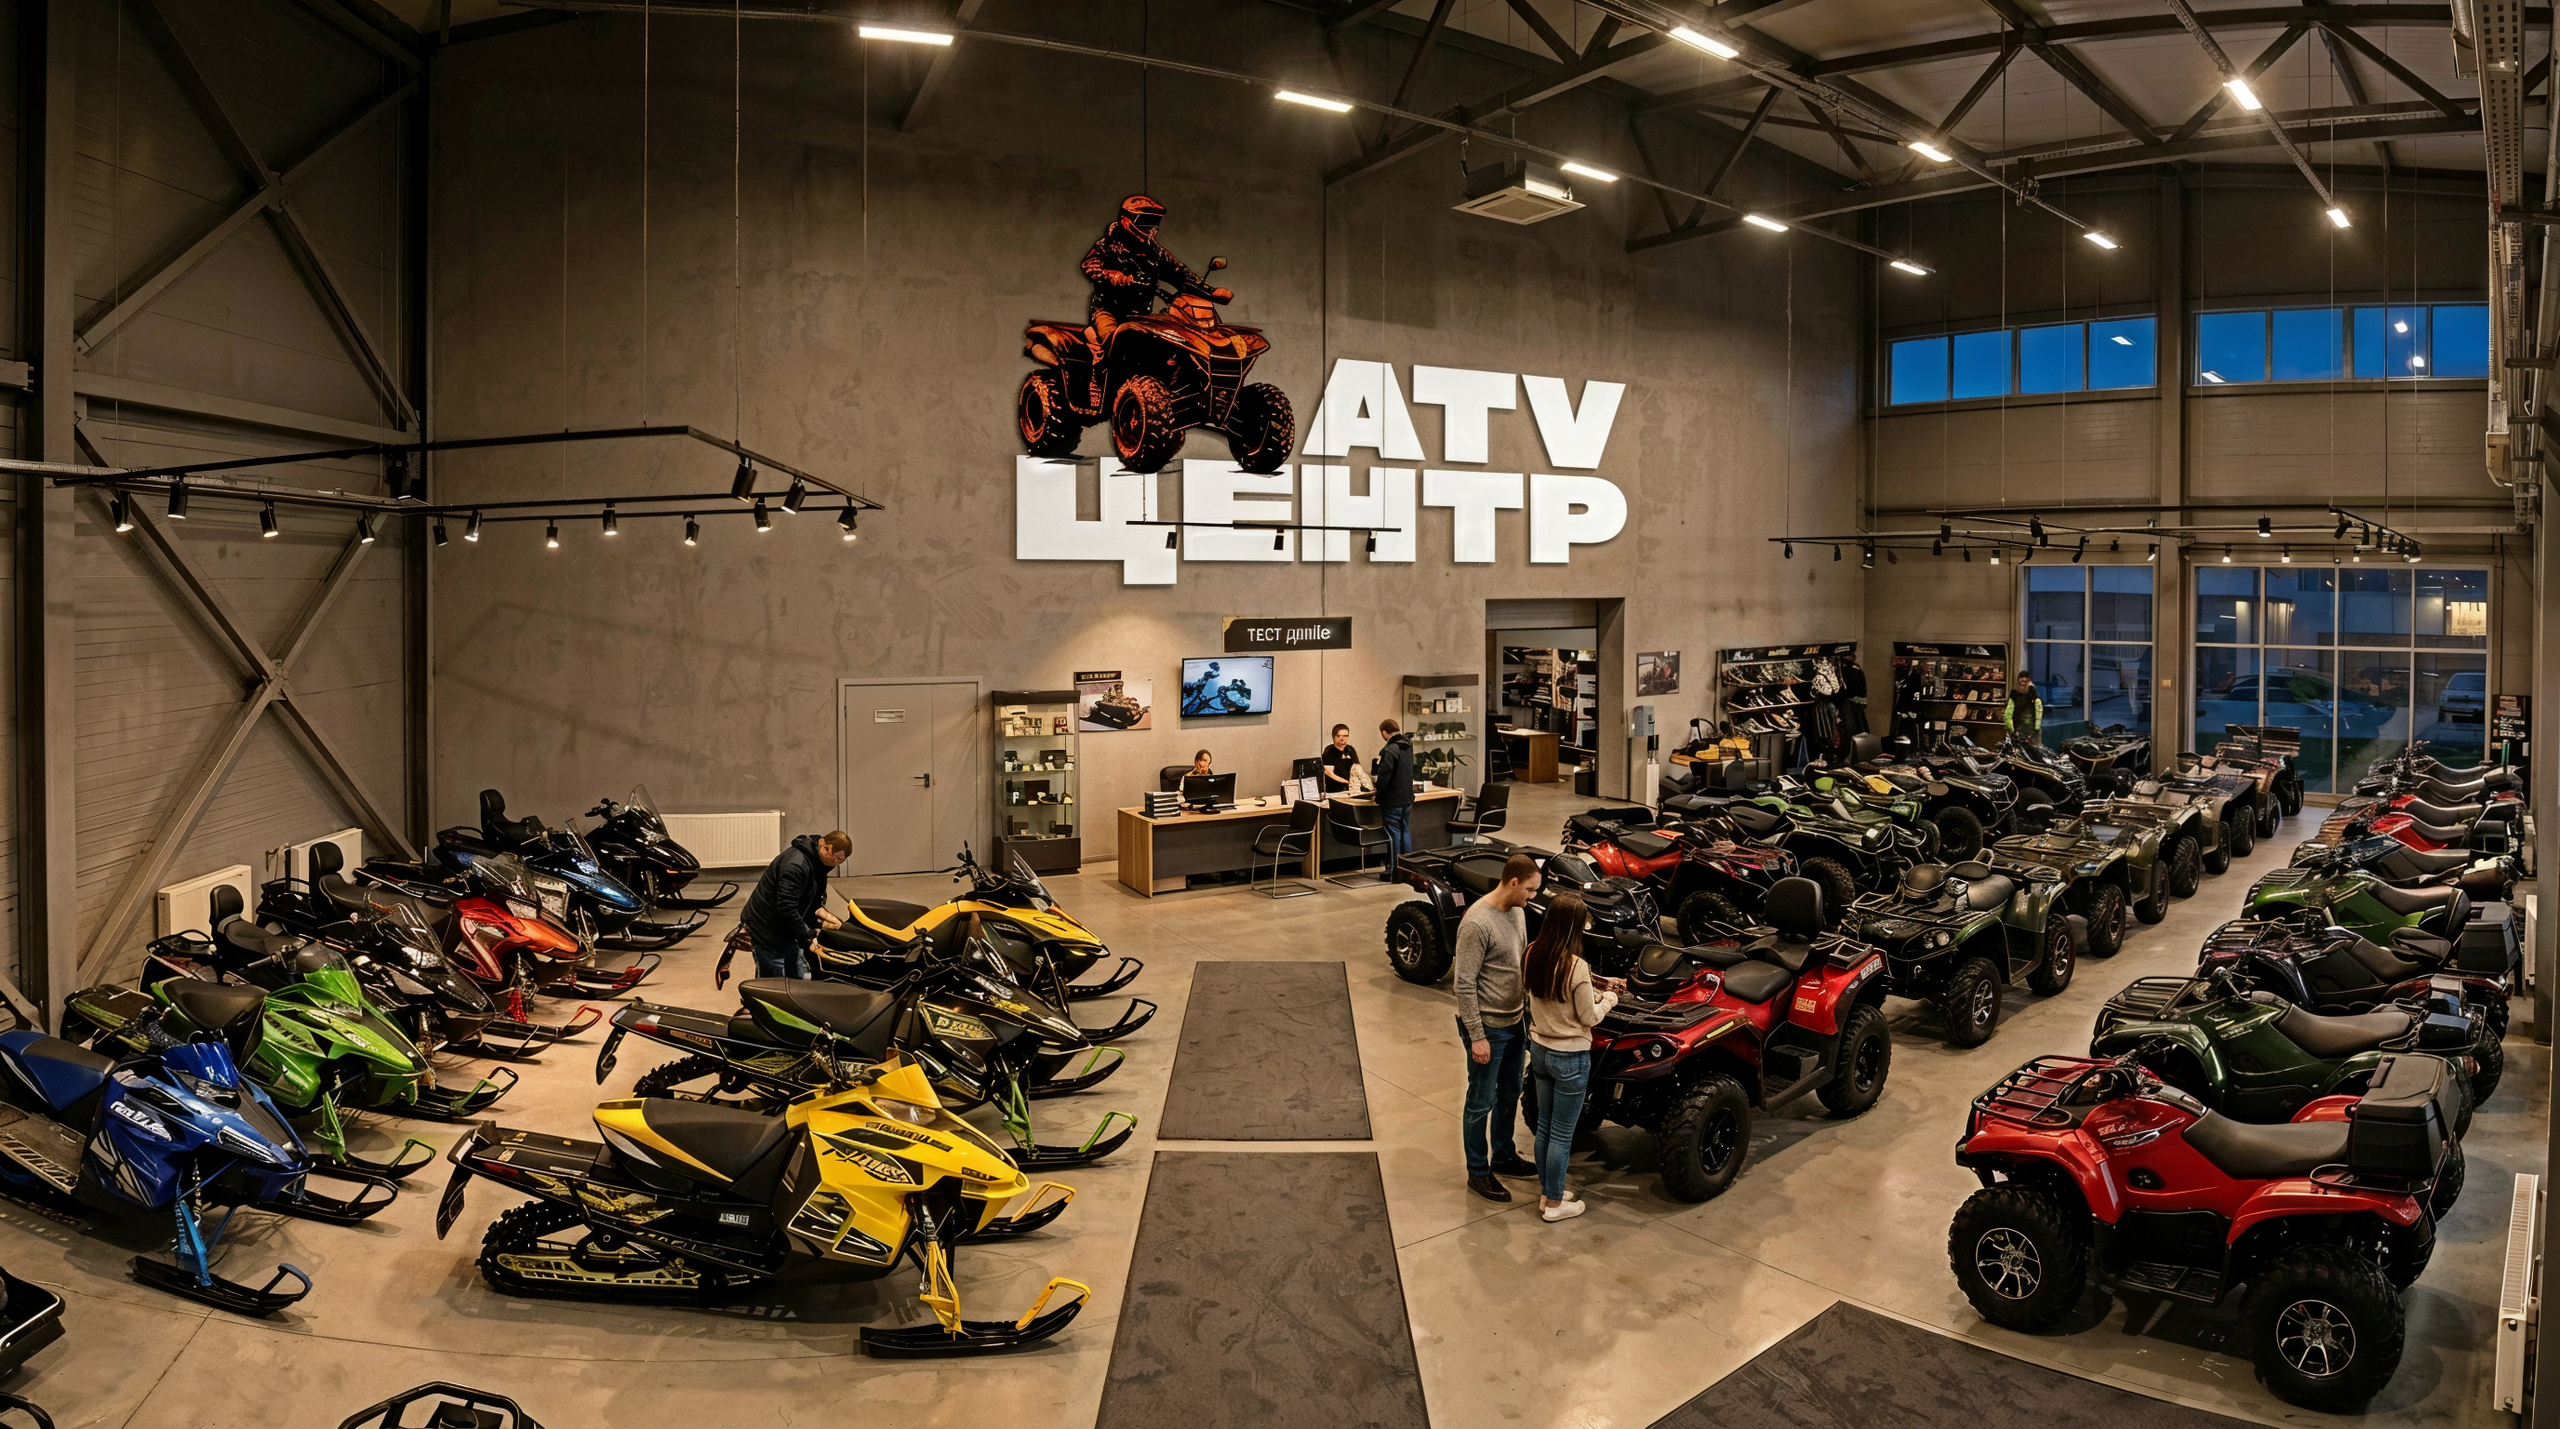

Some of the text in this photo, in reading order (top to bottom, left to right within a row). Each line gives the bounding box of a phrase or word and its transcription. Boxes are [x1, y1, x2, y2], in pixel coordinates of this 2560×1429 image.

[1301, 358, 1626, 469] ATV
[1016, 455, 1628, 585] ЦЕНТР
[1247, 627, 1282, 642] ТЕСТ
